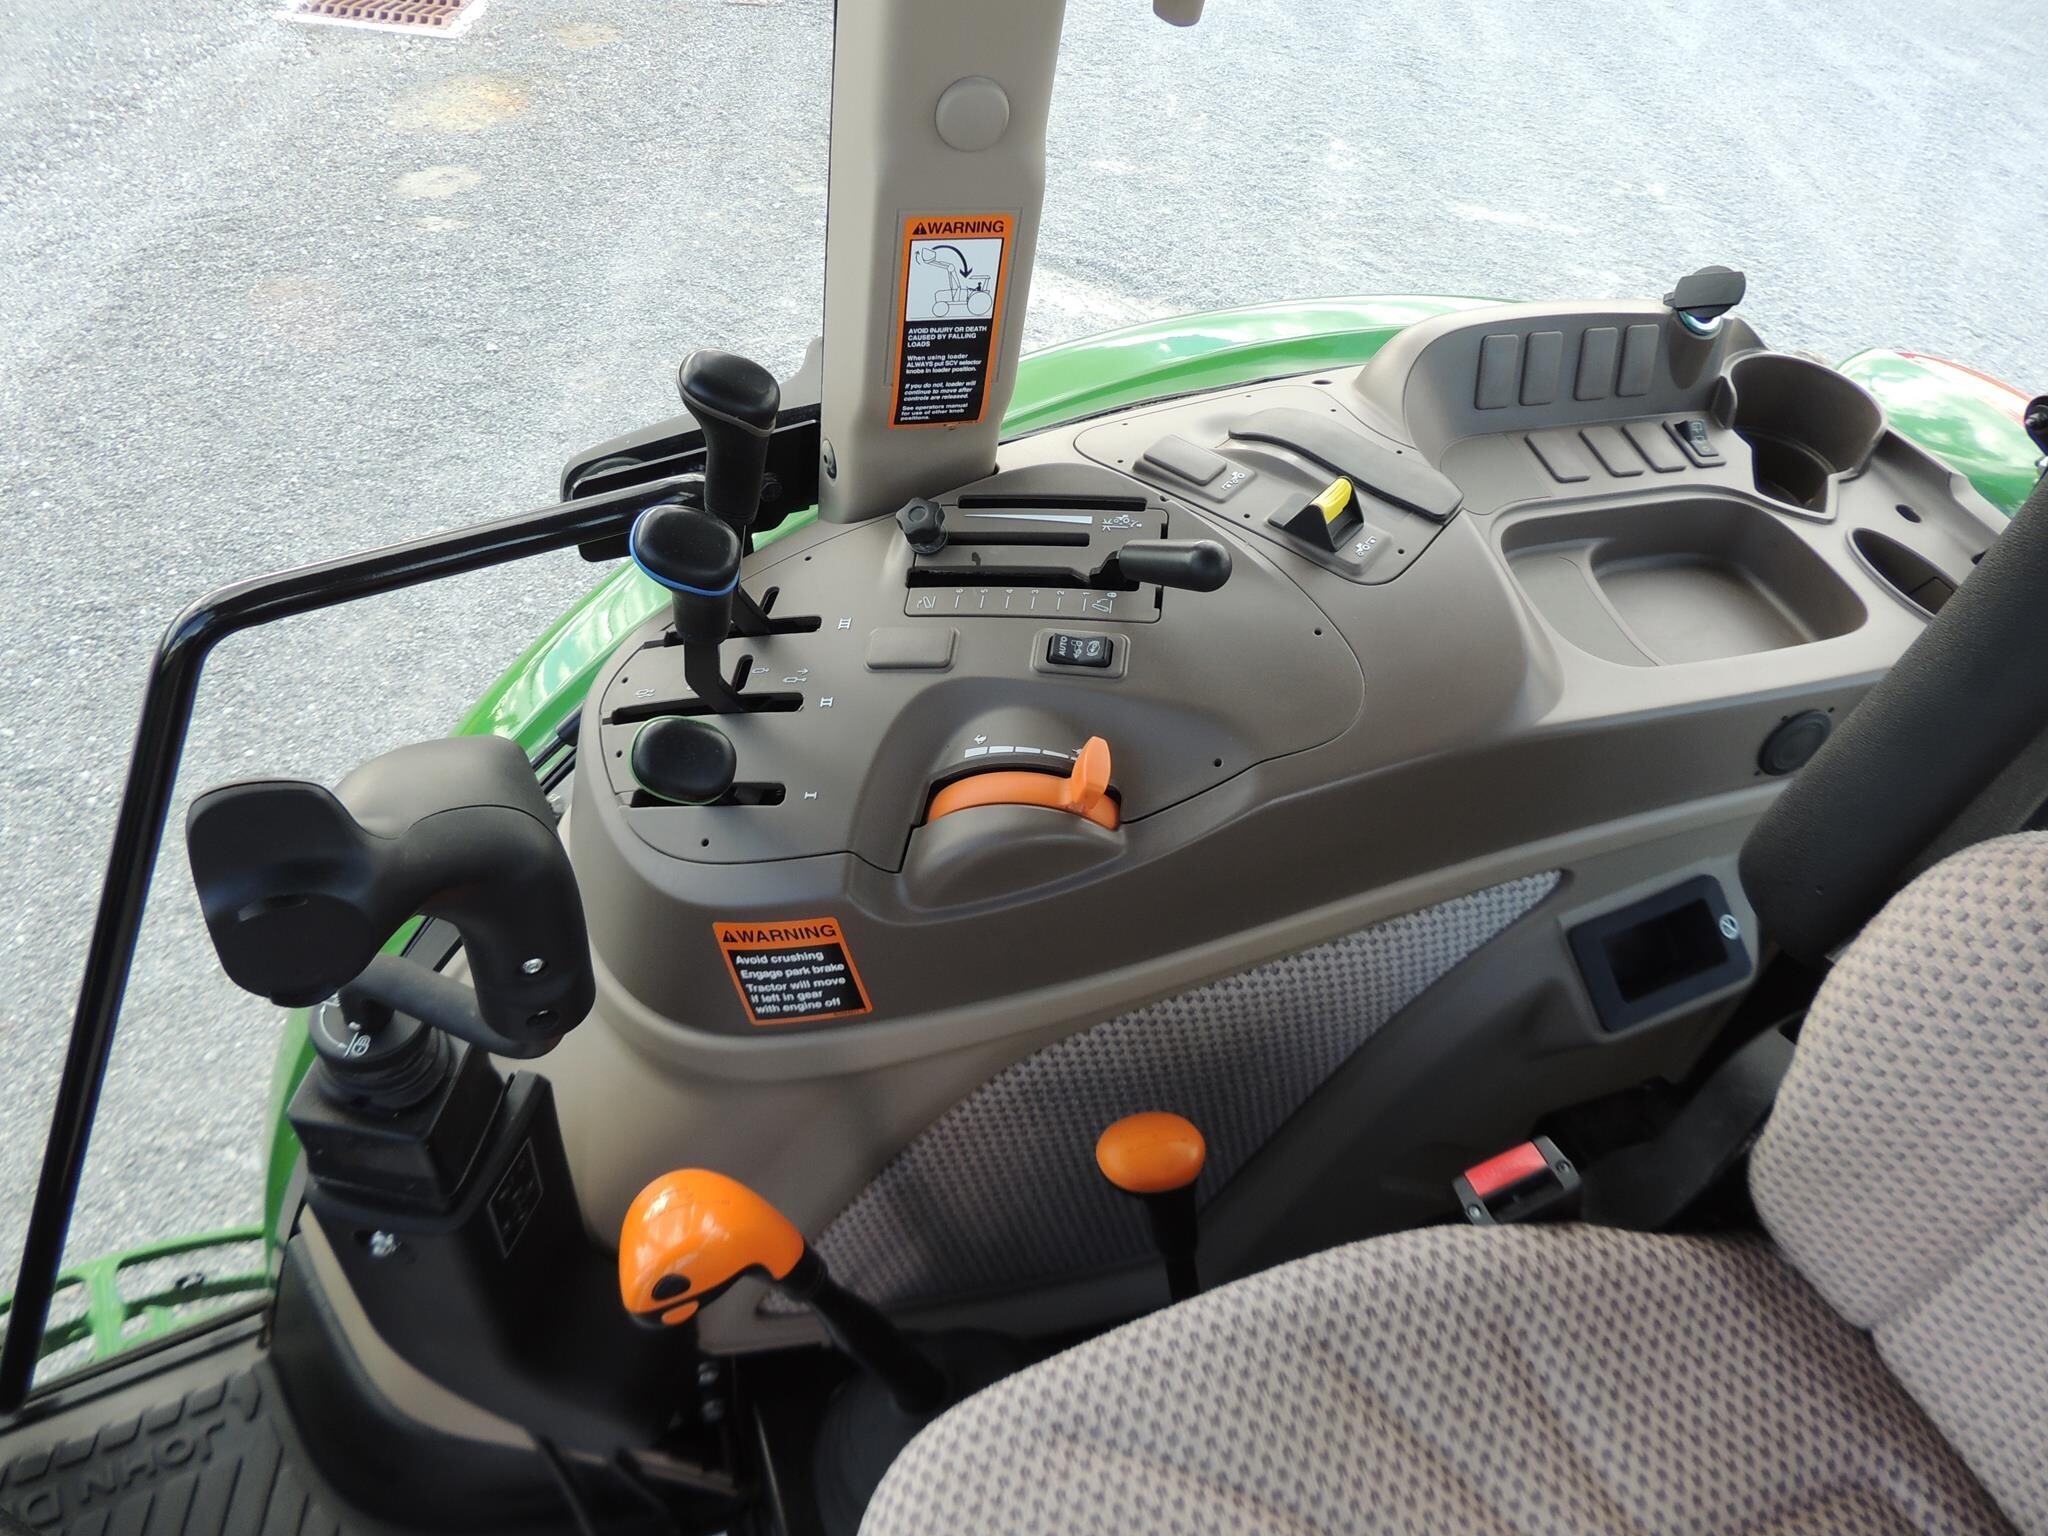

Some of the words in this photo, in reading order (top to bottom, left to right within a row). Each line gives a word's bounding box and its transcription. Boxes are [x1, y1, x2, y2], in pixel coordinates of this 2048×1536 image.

[928, 220, 1004, 234] WARNING
[1058, 636, 1068, 656] AUTO
[736, 924, 836, 943] WARNING
[736, 955, 768, 964] Avoid
[770, 951, 824, 964] crushing
[740, 969, 782, 980] Engage
[785, 967, 810, 978] park
[812, 963, 844, 973] brake
[746, 982, 786, 993] Tractor
[790, 980, 810, 990] will
[813, 976, 846, 987] move
[751, 993, 758, 1003] if
[762, 992, 780, 1002] left
[783, 991, 794, 1001] in
[797, 989, 823, 1002] gear
[755, 1003, 780, 1014] with
[782, 1000, 822, 1012] engine
[824, 998, 840, 1006] off
[79, 1418, 227, 1506] JOHN
